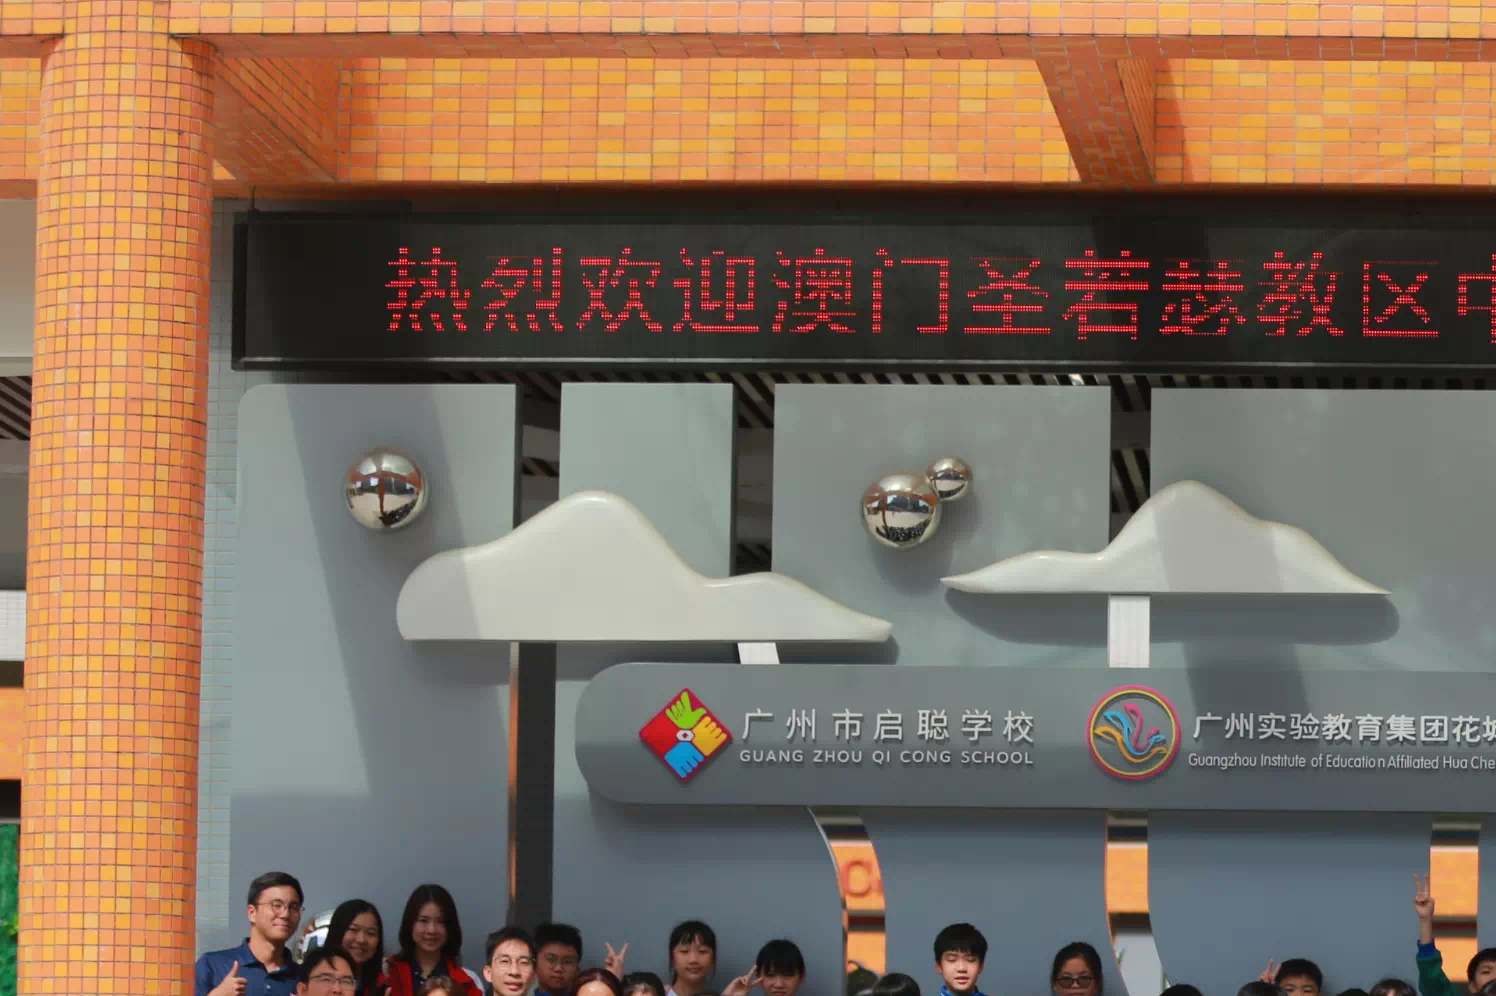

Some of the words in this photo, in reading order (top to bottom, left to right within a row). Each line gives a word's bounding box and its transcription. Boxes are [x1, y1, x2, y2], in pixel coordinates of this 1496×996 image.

[741, 708, 1034, 743] 广州市启聪学校
[739, 749, 803, 763] GUANG
[813, 750, 862, 763] ZHOU
[872, 750, 890, 765] QI
[900, 750, 951, 763] CONG
[960, 751, 1034, 764] SCHOOL
[1188, 753, 1257, 770] Guangzhou
[1260, 753, 1307, 768] Institute
[1311, 754, 1324, 768] of
[1326, 754, 1385, 768] Education
[1387, 755, 1439, 769] Affiliated
[1442, 756, 1468, 769] Hua
